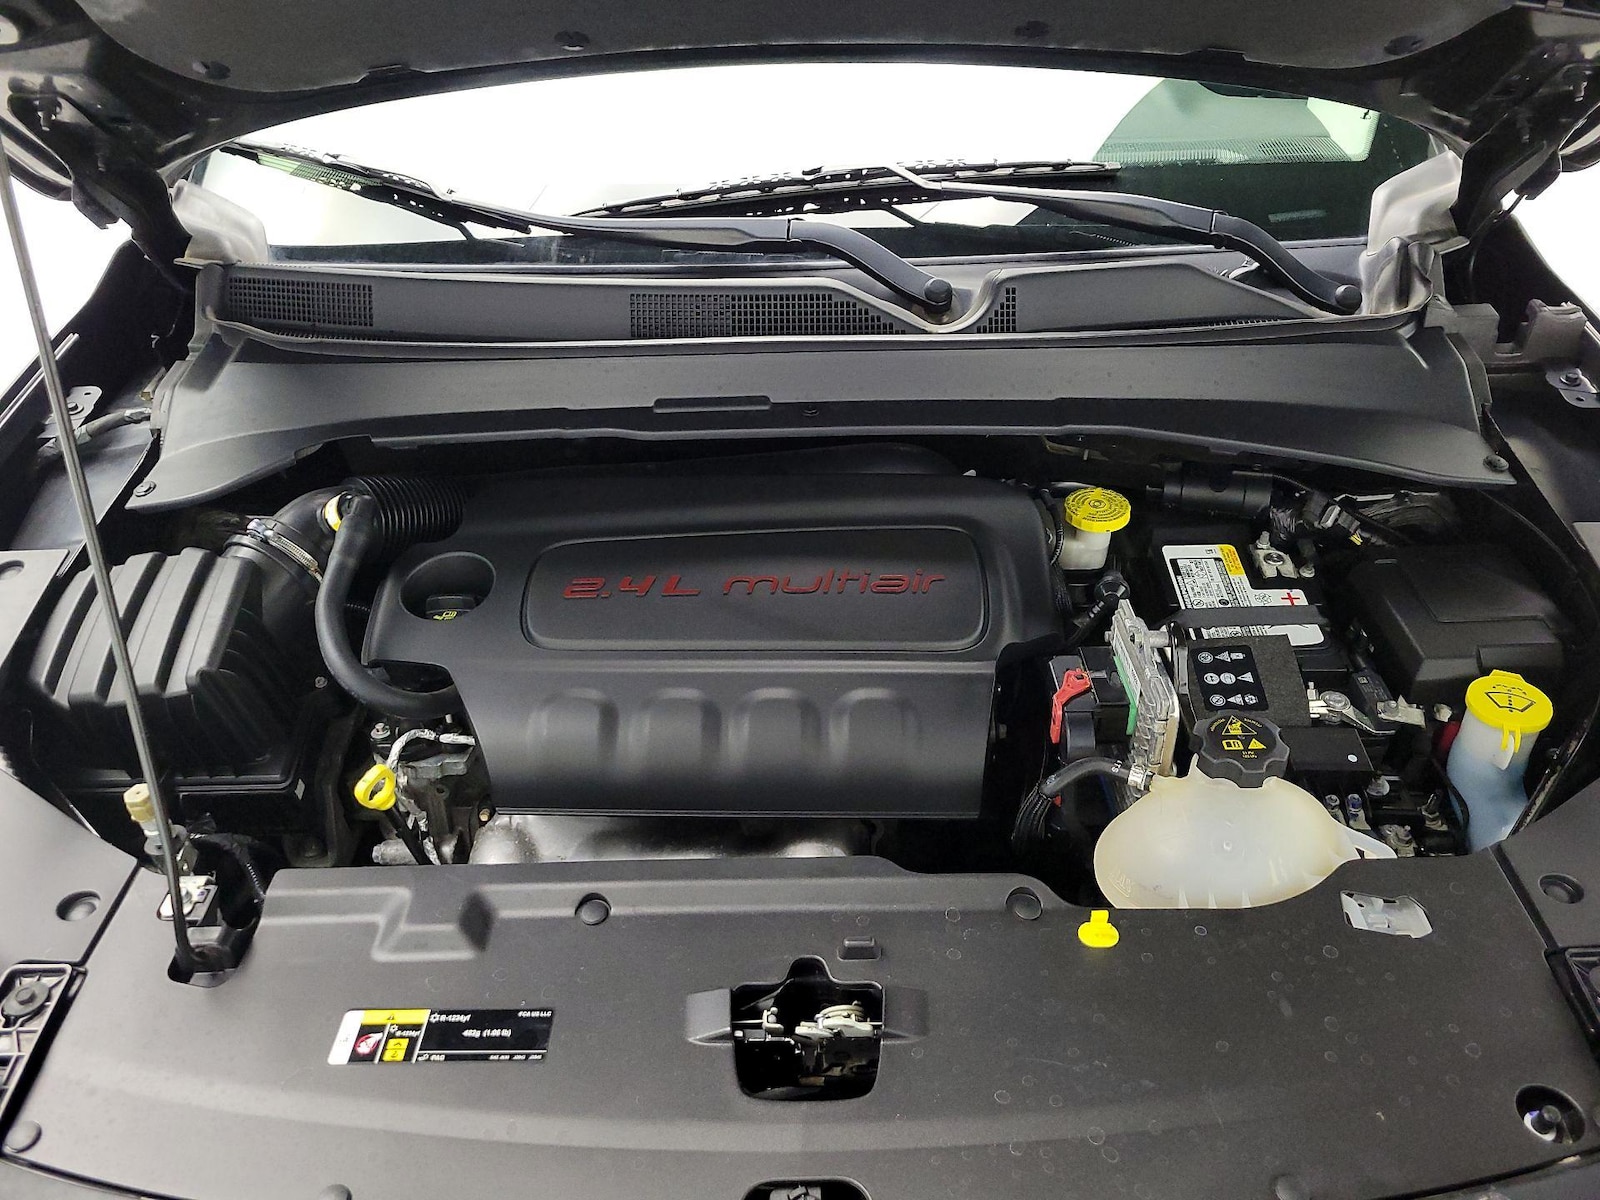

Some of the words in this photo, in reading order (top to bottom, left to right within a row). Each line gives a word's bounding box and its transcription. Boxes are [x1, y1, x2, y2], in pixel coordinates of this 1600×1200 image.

[564, 575, 700, 599] 2.4L
[723, 568, 945, 594] multiair
[440, 1014, 471, 1023] R-1234yf
[540, 1010, 552, 1018] LLC
